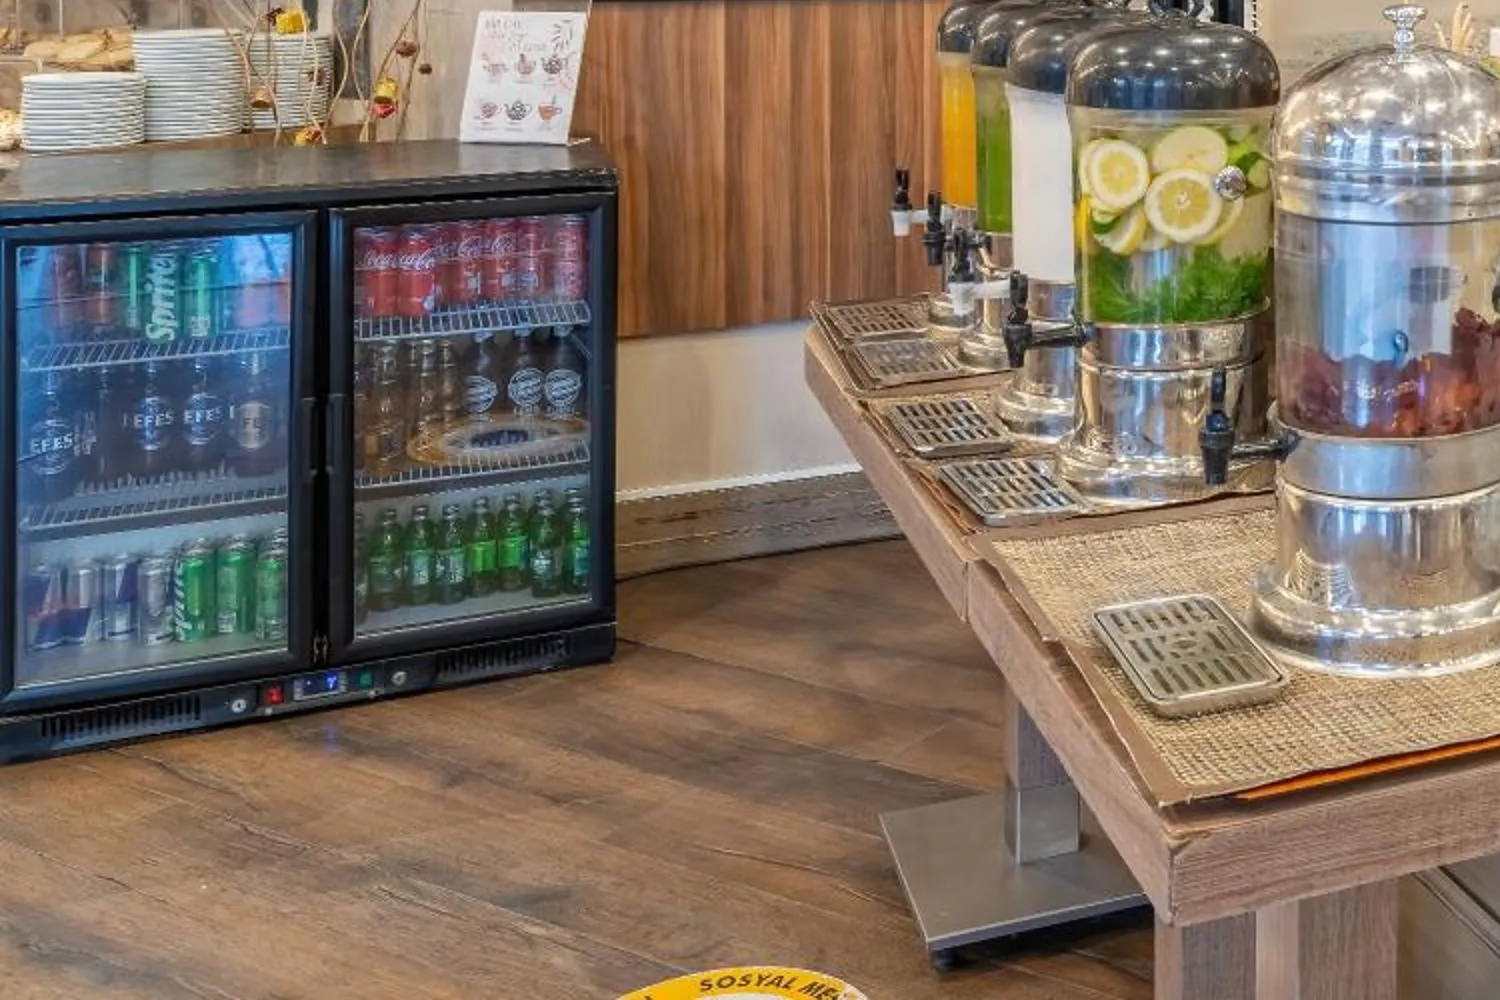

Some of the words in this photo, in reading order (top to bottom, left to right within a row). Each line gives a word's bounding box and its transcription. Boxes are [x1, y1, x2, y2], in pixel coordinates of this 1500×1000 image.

[145, 253, 178, 341] Sprite
[133, 411, 174, 428] EFES
[699, 973, 798, 993] SOSYAL
